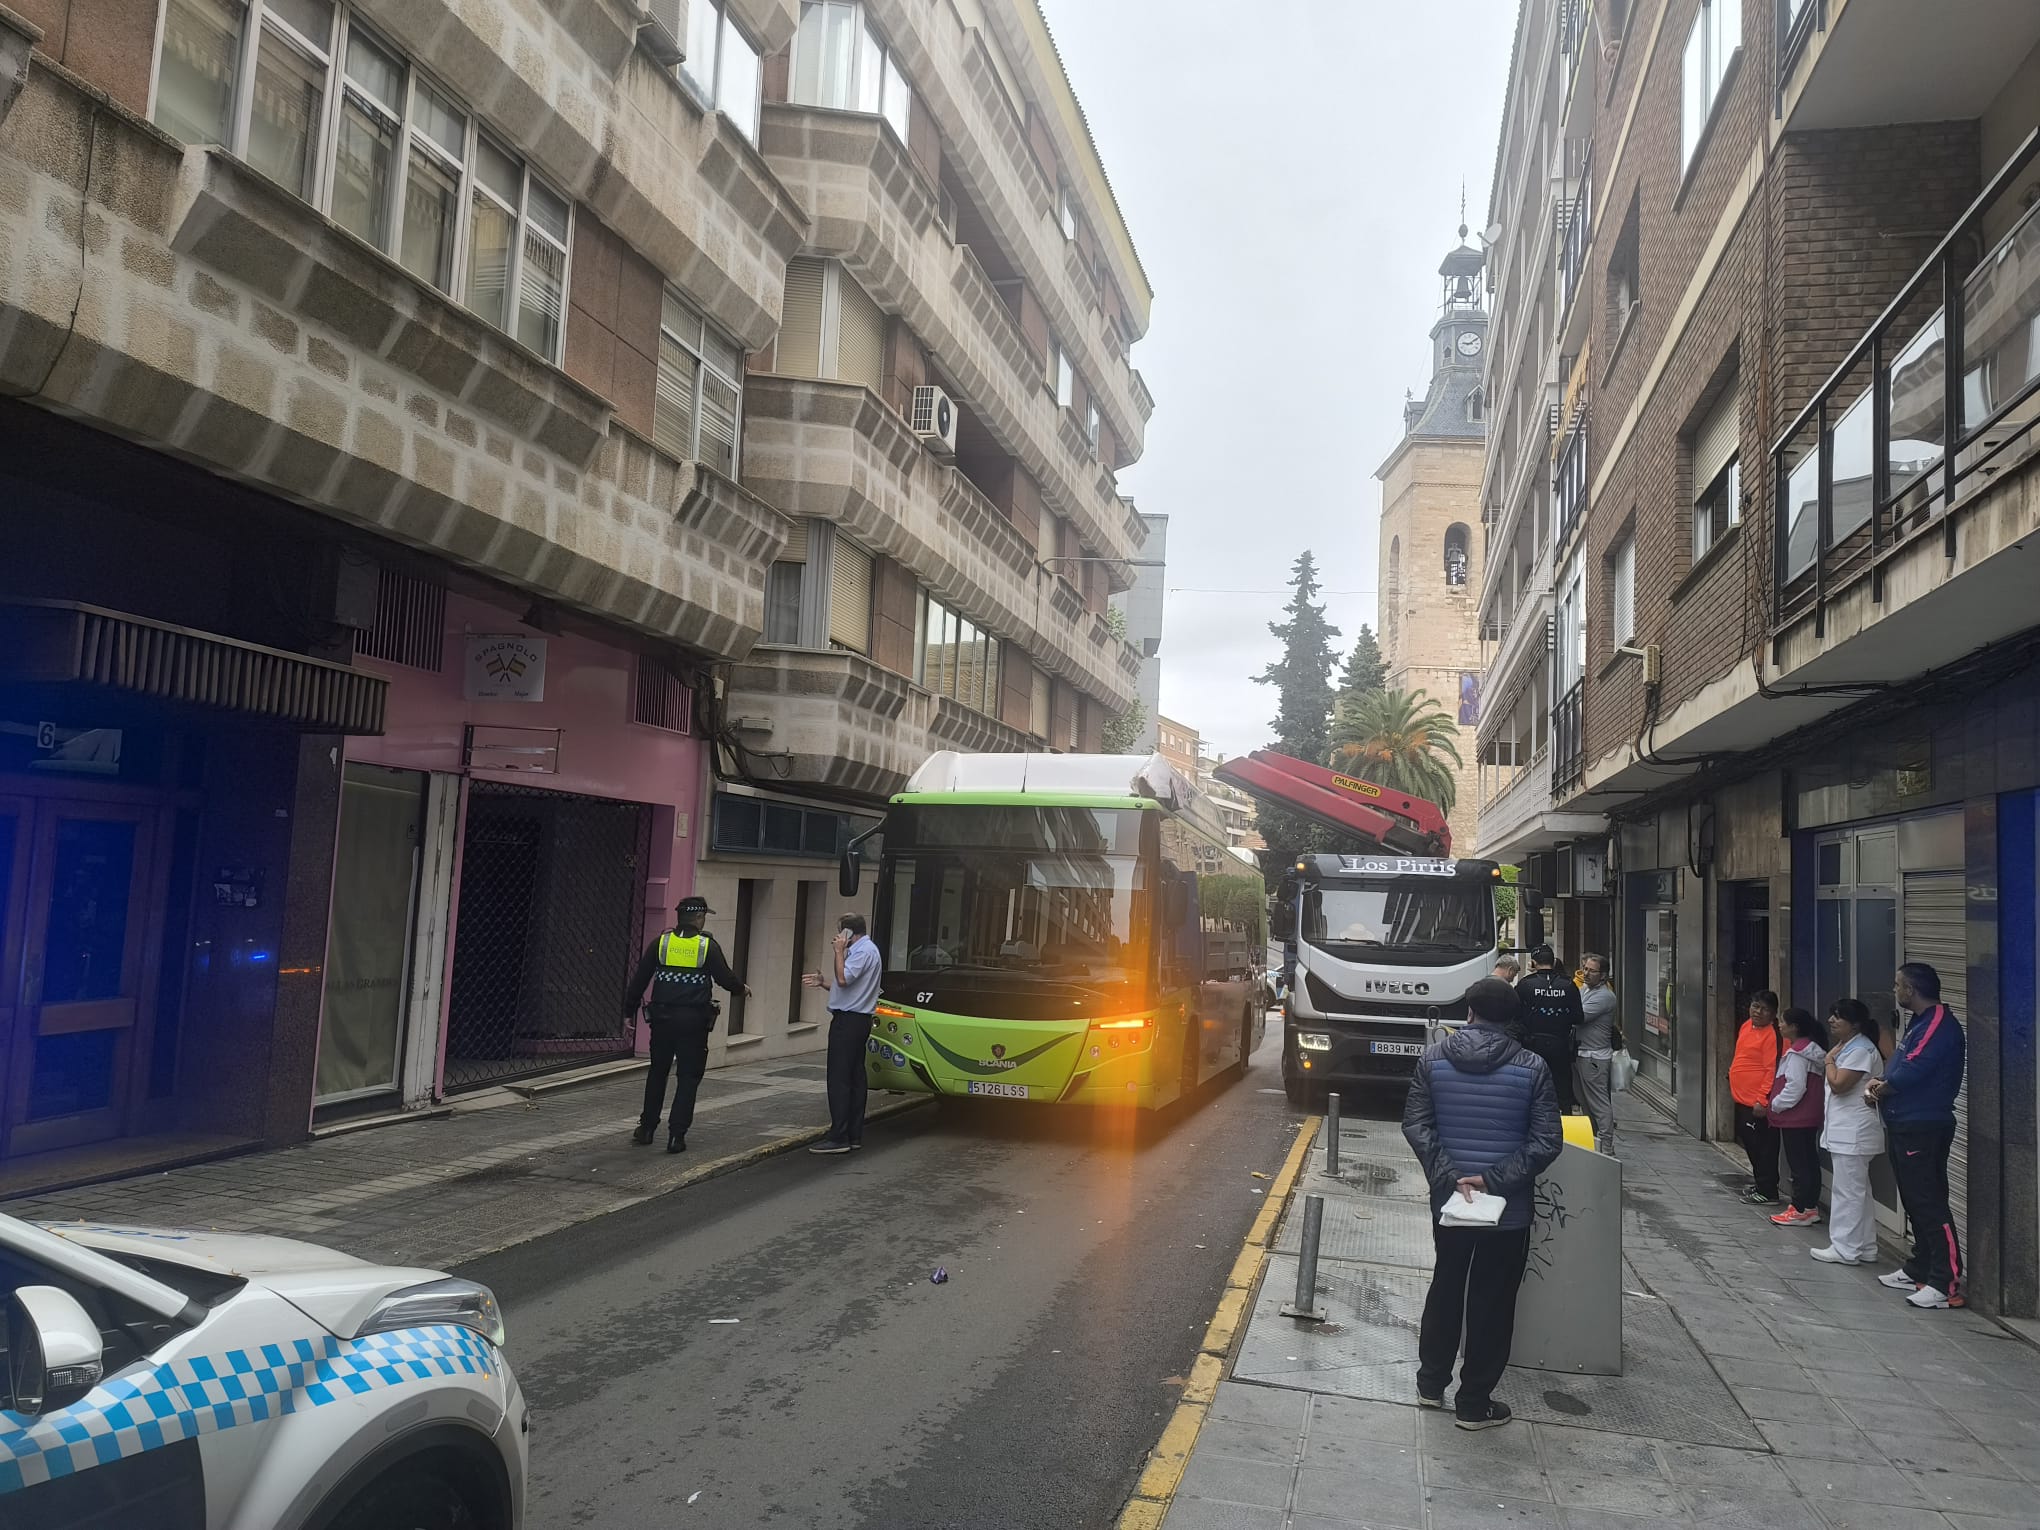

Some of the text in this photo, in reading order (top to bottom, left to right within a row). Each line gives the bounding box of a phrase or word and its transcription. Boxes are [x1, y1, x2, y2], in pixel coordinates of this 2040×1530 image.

[474, 642, 538, 662] SPAGNOLO
[40, 723, 54, 746] 6
[1334, 776, 1378, 796] PALFINGER
[1349, 858, 1456, 873] Los Pirris
[1365, 979, 1430, 995] IVECO
[1534, 988, 1566, 997] POLICIA
[916, 991, 933, 1003] 67
[1377, 1043, 1422, 1055] 8839 MRX
[978, 1059, 1017, 1069] SCANIA
